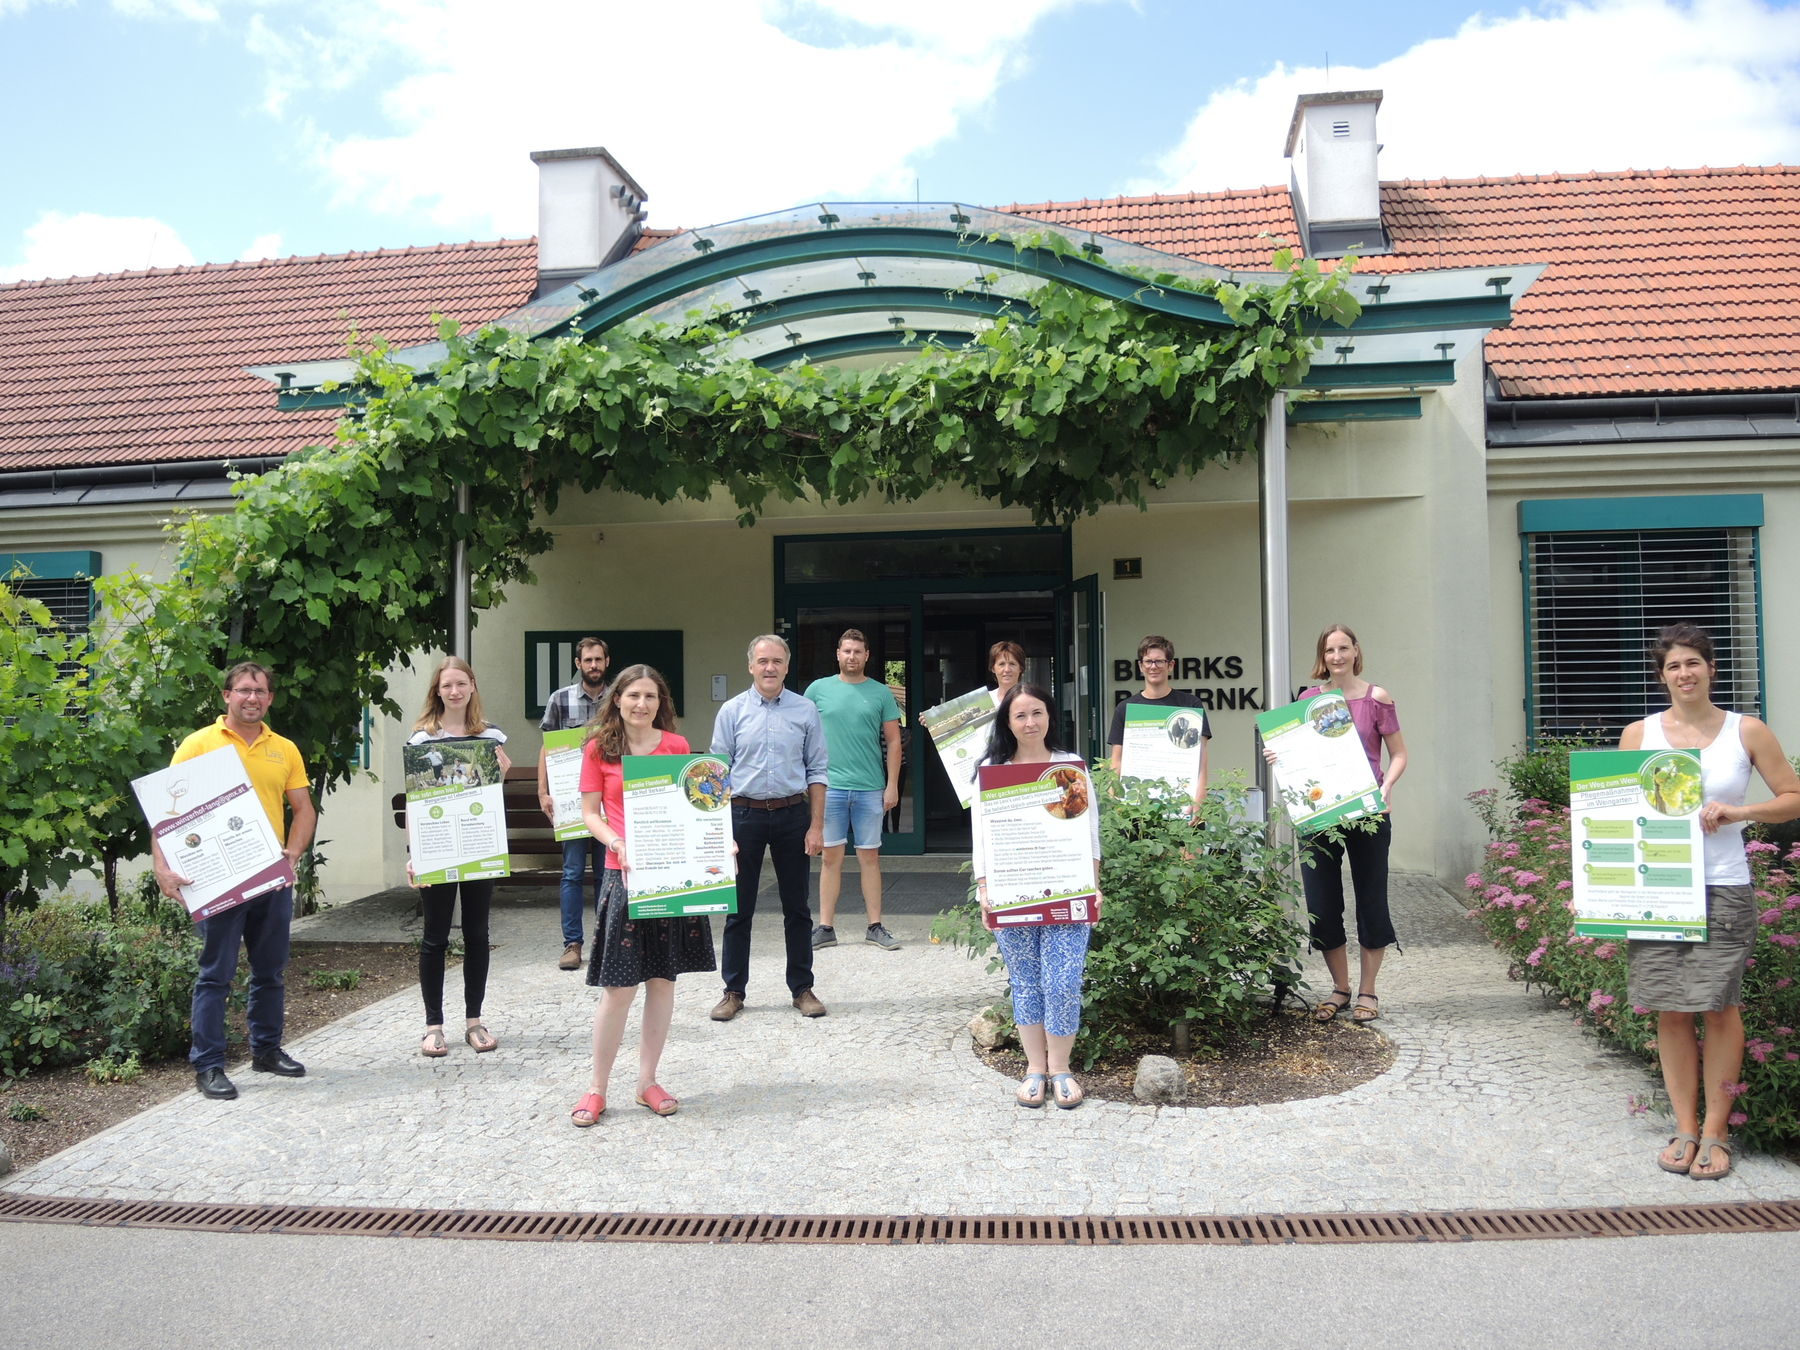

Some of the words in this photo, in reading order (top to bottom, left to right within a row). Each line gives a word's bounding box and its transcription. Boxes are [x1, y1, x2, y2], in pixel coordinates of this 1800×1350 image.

[1114, 656, 1243, 681] BEIRKS
[1589, 781, 1605, 789] Weg
[1580, 787, 1639, 799] Pflegemaßnahmen
[1595, 797, 1633, 807] Weingarten
